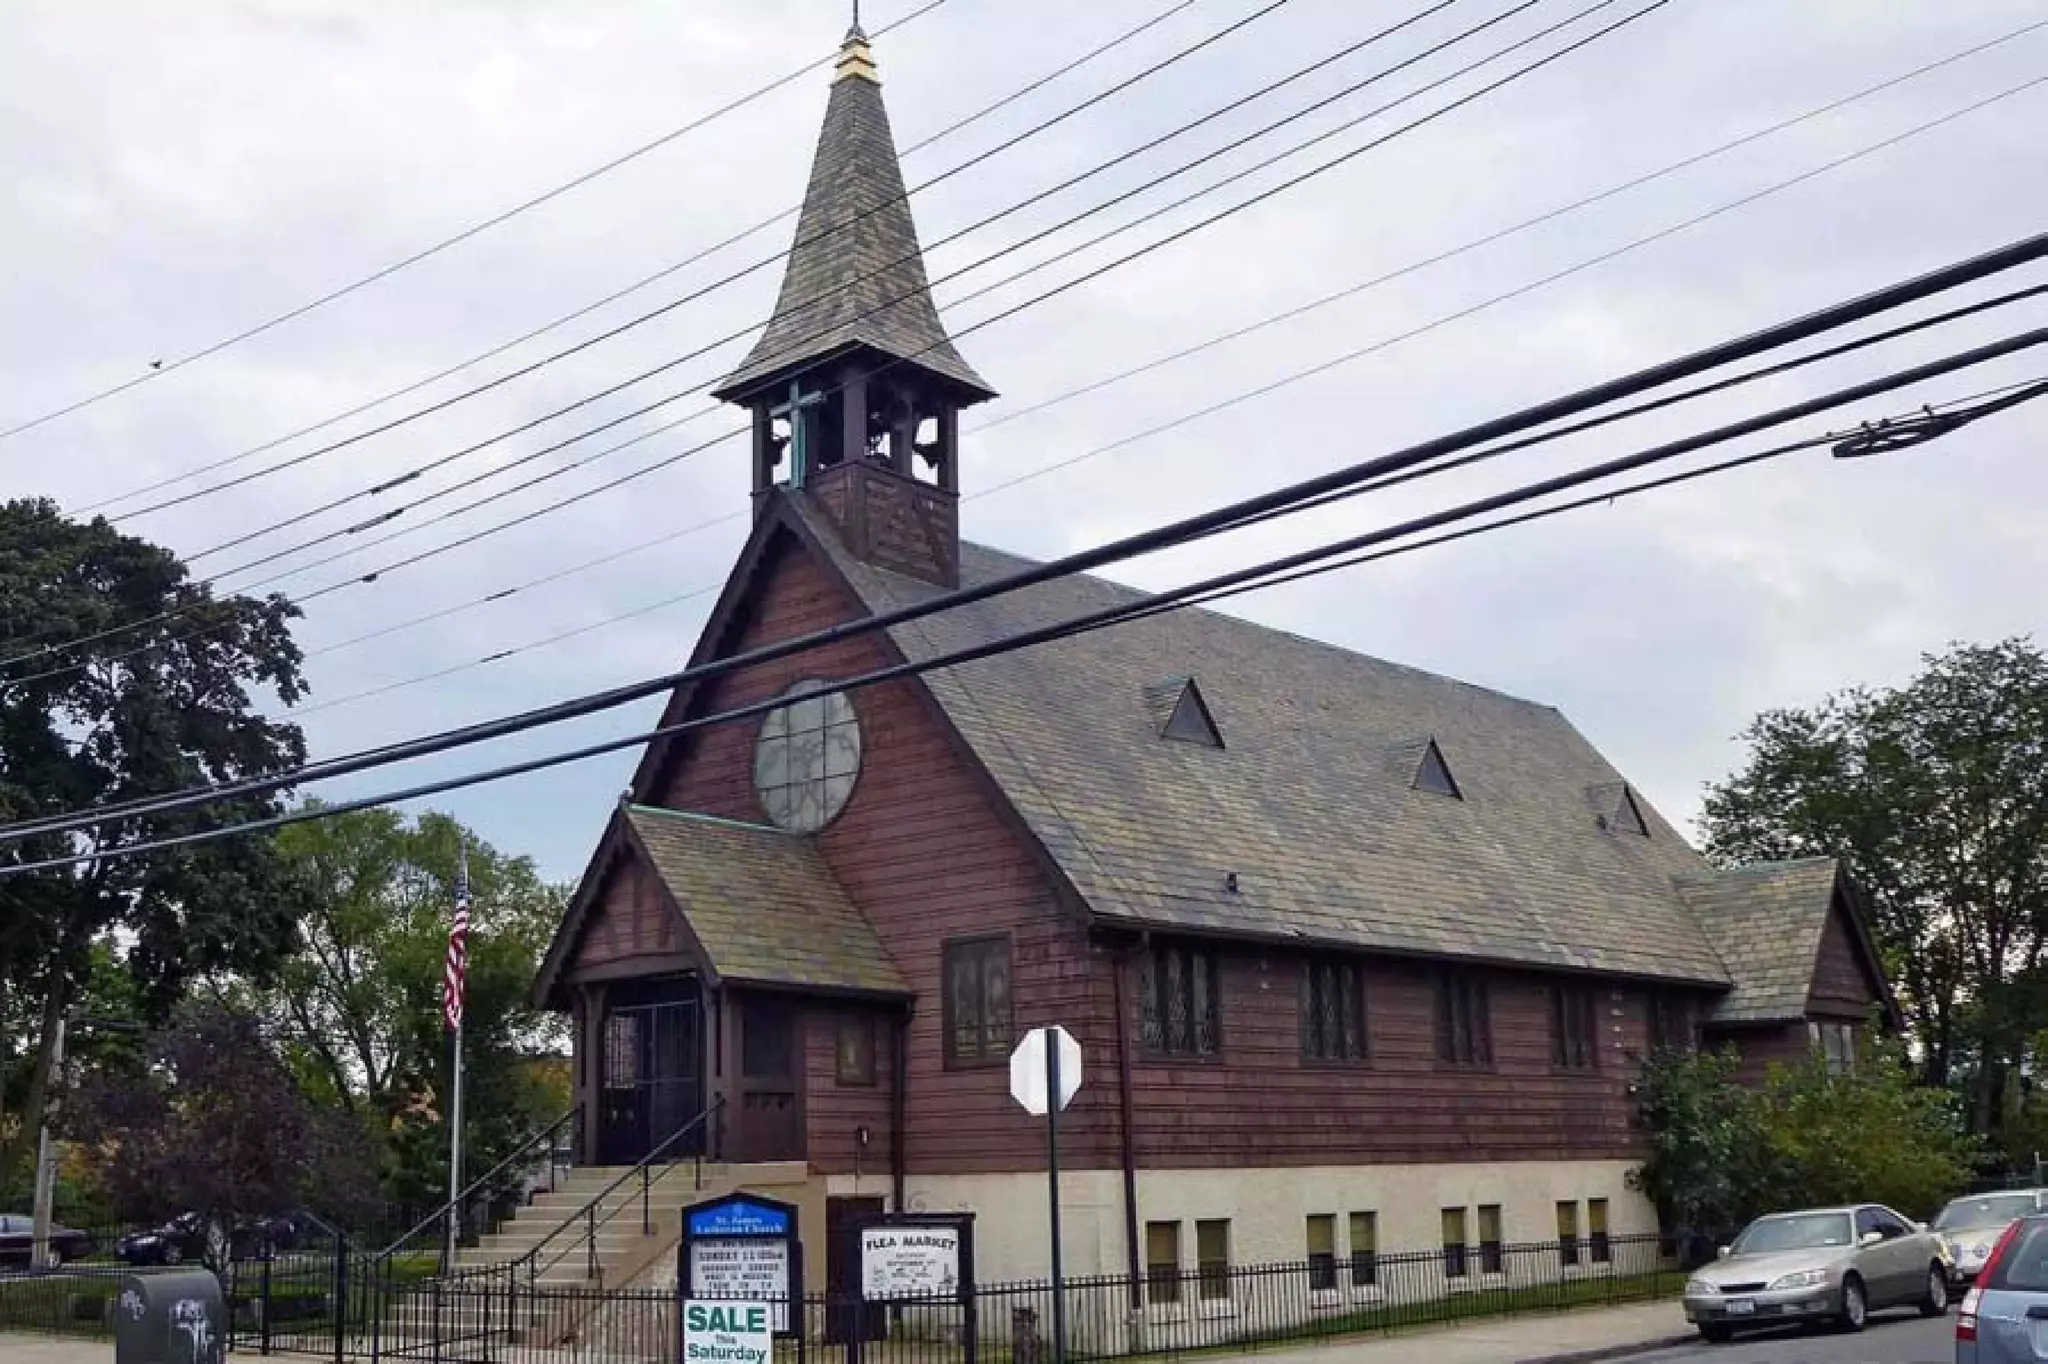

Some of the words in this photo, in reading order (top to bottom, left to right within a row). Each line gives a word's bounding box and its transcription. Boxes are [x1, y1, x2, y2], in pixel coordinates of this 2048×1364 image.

[866, 1237, 897, 1251] FLEA
[902, 1235, 957, 1250] MARKET
[688, 1305, 767, 1333] SALE
[688, 1343, 767, 1364] Saturday
